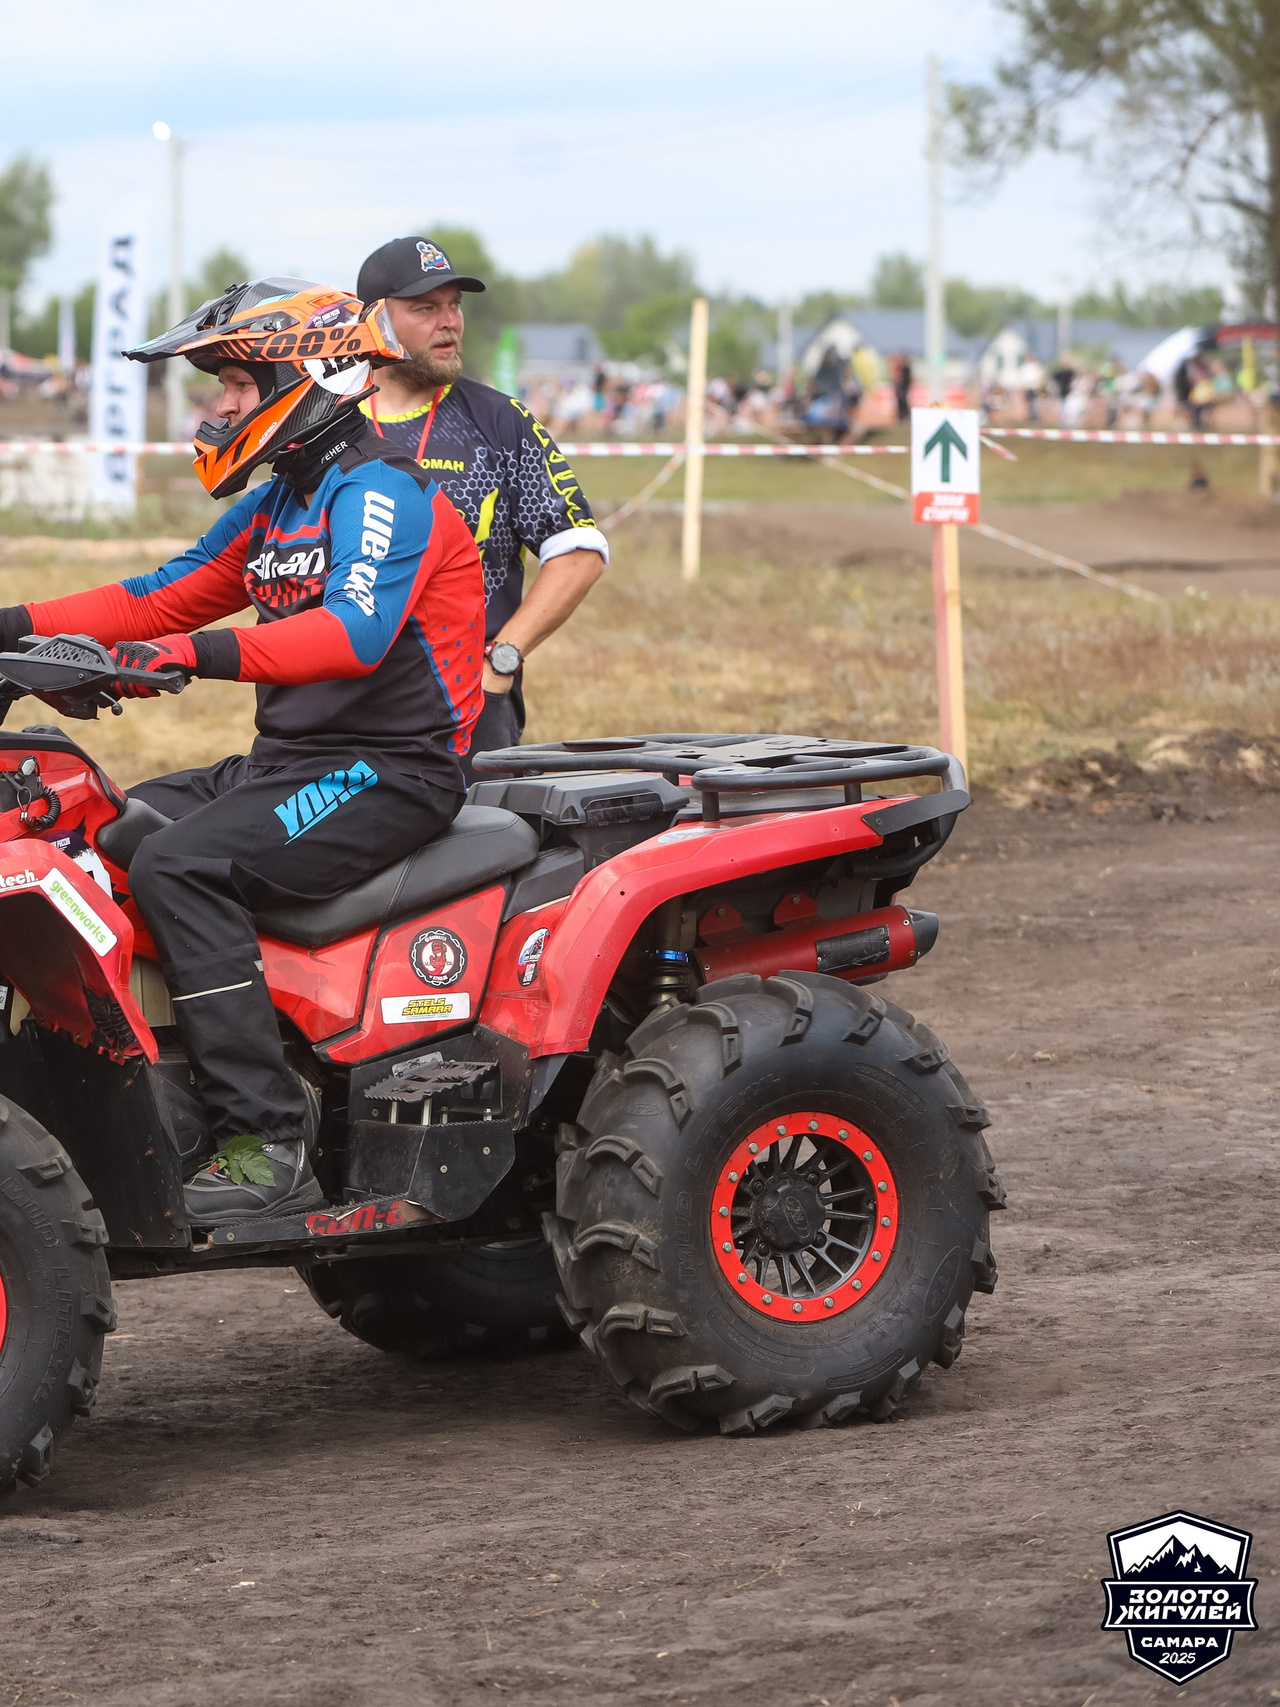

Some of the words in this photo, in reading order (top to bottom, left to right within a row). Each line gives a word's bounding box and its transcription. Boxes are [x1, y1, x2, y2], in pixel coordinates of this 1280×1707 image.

[414, 458, 465, 472] ОМАН
[49, 880, 107, 944] greenworks
[408, 997, 447, 1008] STELS
[305, 1200, 408, 1234] can-a
[52, 1266, 74, 1355] LITE
